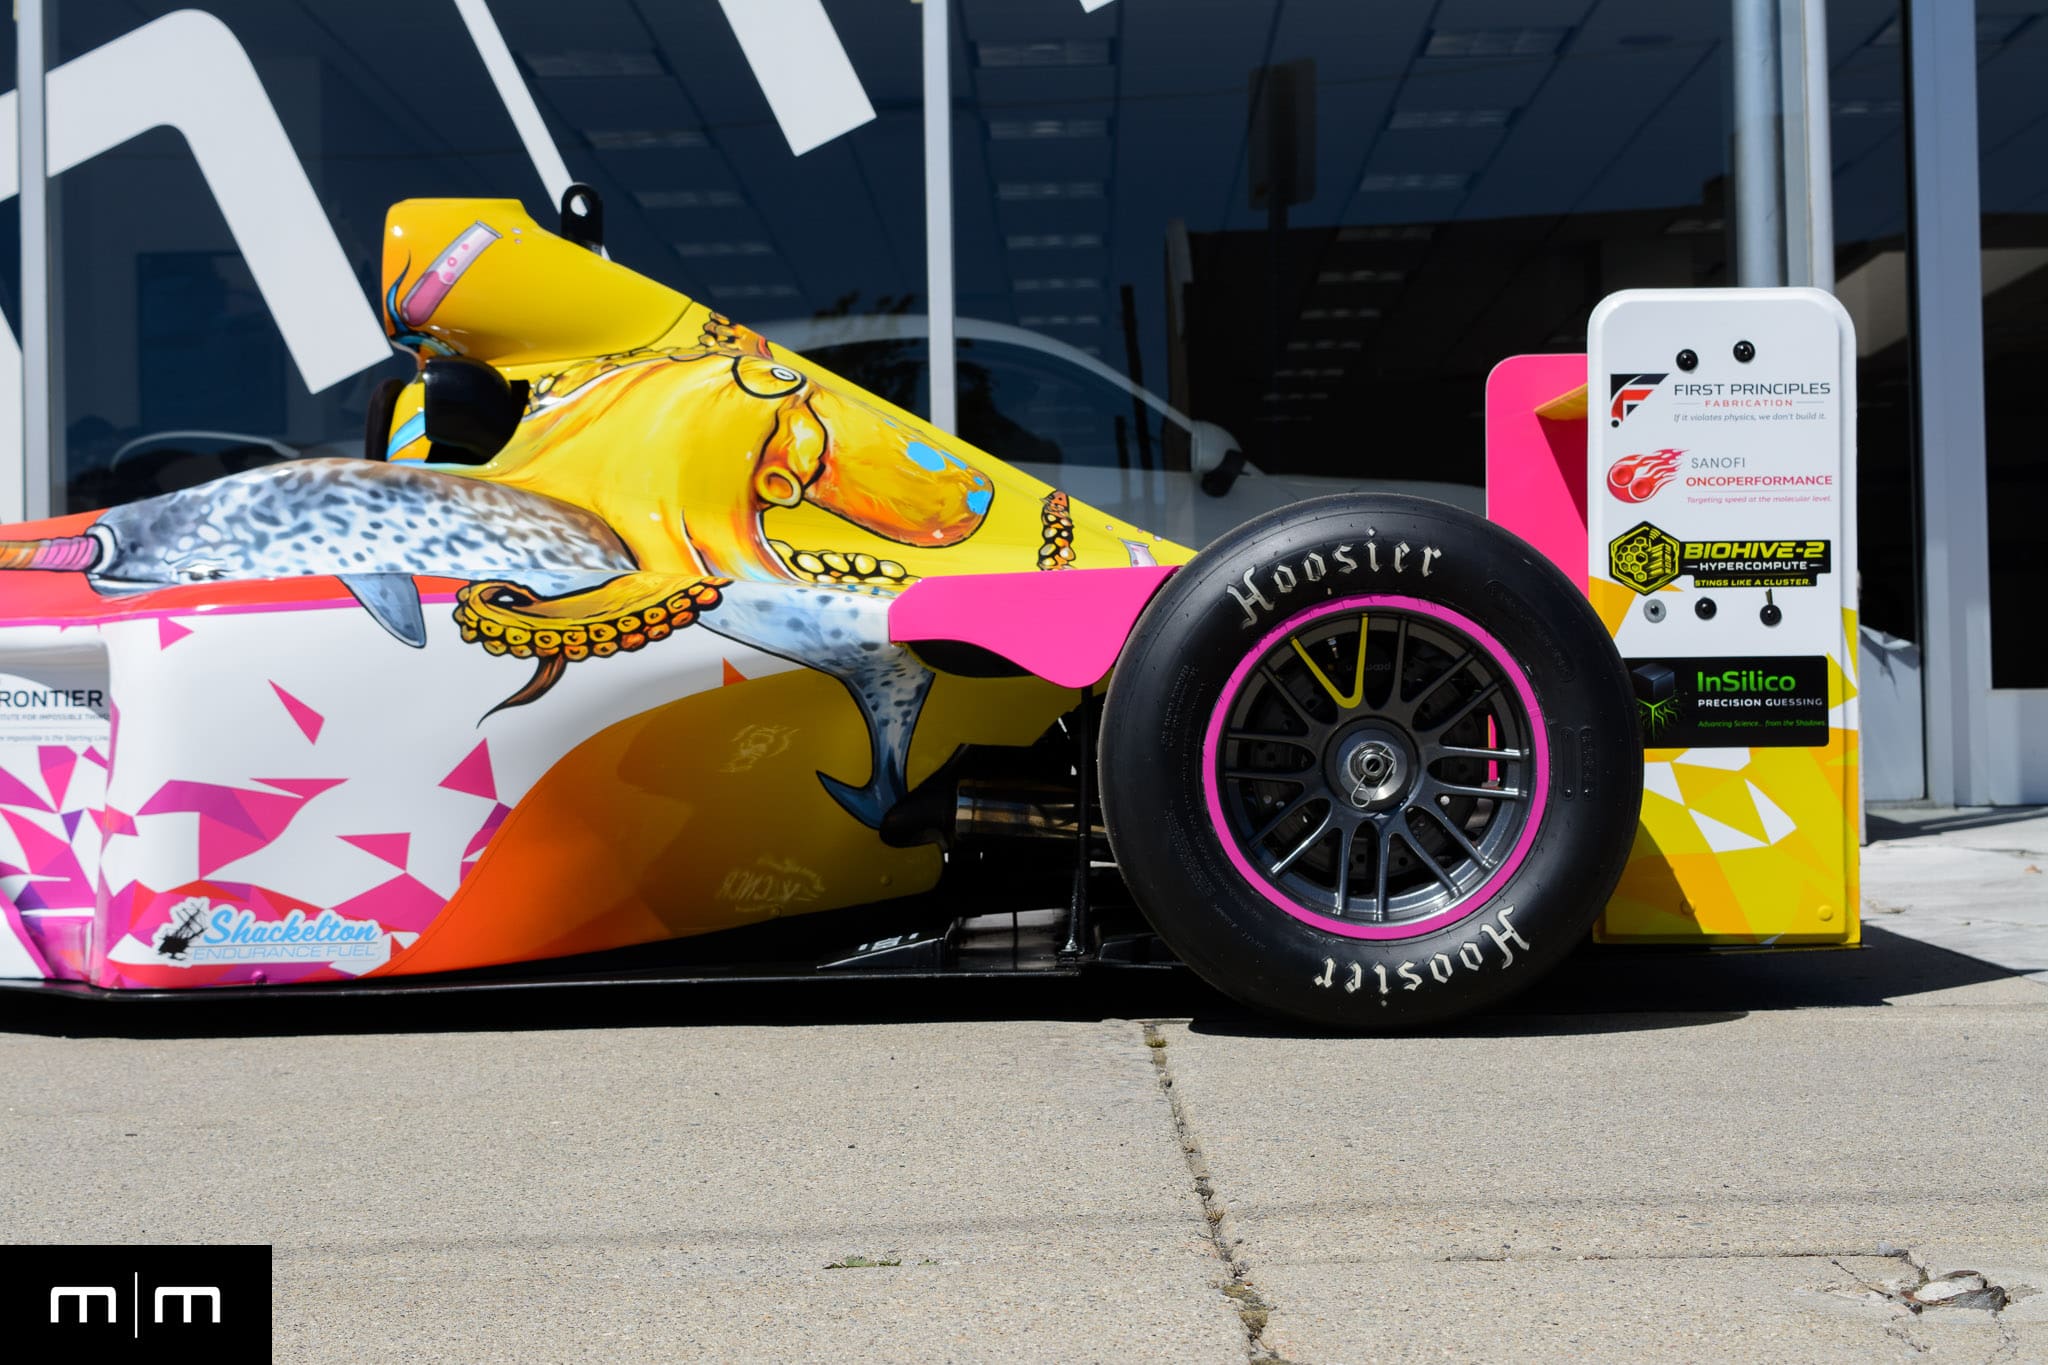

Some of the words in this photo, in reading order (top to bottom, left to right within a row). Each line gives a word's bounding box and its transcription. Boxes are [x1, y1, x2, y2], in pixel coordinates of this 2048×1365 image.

[1674, 383, 1725, 396] FIRST
[1731, 382, 1831, 395] PRINCIPLES
[1704, 399, 1793, 408] FABRICATION
[1673, 413, 1681, 423] If
[1690, 414, 1722, 422] violates
[1723, 413, 1756, 423] physics,
[1772, 412, 1793, 421] don't
[1796, 412, 1816, 420] build
[1690, 457, 1746, 469] SANOFI
[1685, 475, 1833, 487] ONCOPERFORMANCE
[1687, 496, 1723, 505] Targeting
[1724, 495, 1747, 504] speed
[1758, 495, 1771, 503] the
[1773, 495, 1811, 503] molecular
[1683, 541, 1825, 559] BIOHIVE-2
[1700, 561, 1808, 571] HYPERCOMPUTE
[1226, 527, 1442, 630] Hoosier
[1695, 579, 1729, 587] STINGS
[1731, 579, 1752, 587] LIKE
[1752, 578, 1761, 586] A
[1763, 578, 1811, 586] CLUSTER.
[1697, 670, 1796, 692] InSilico
[1698, 699, 1762, 708] PRECISION
[1765, 698, 1823, 707] GUESSING
[1697, 720, 1733, 729] Advancing
[1783, 719, 1794, 727] the
[203, 908, 377, 943] Shackelton
[193, 945, 321, 961] ENDURANCE
[326, 943, 376, 957] FUEL
[1314, 904, 1530, 1007] Hoosier
